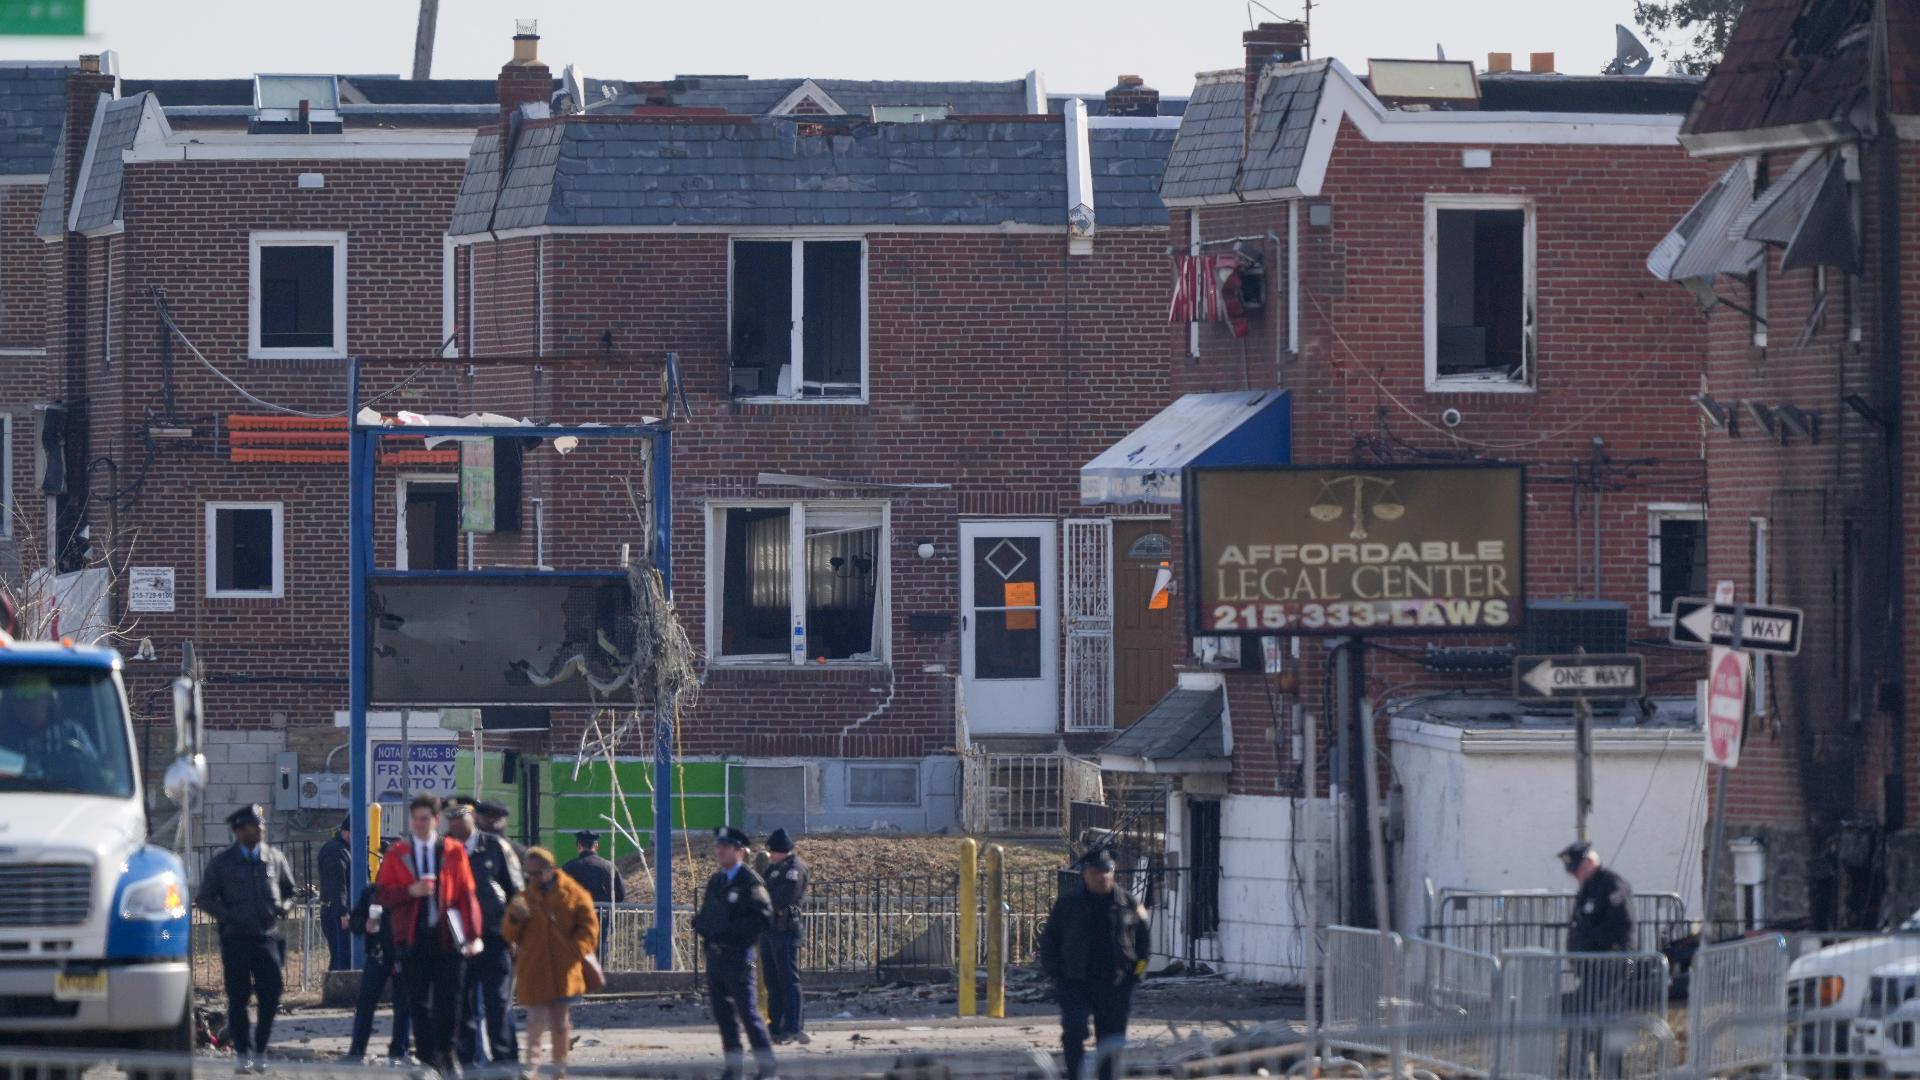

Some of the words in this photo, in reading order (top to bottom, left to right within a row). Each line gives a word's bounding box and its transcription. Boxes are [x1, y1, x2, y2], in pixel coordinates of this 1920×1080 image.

[1218, 540, 1505, 565] AFFORDABLE
[1217, 567, 1342, 600] LEGAL
[1351, 564, 1510, 598] CENTER
[1711, 614, 1736, 634] ON
[1751, 619, 1786, 638] WAY
[1554, 668, 1587, 685] ONE
[1594, 667, 1630, 684] WAY
[378, 747, 412, 758] NOTAY
[417, 747, 438, 758] TAGS
